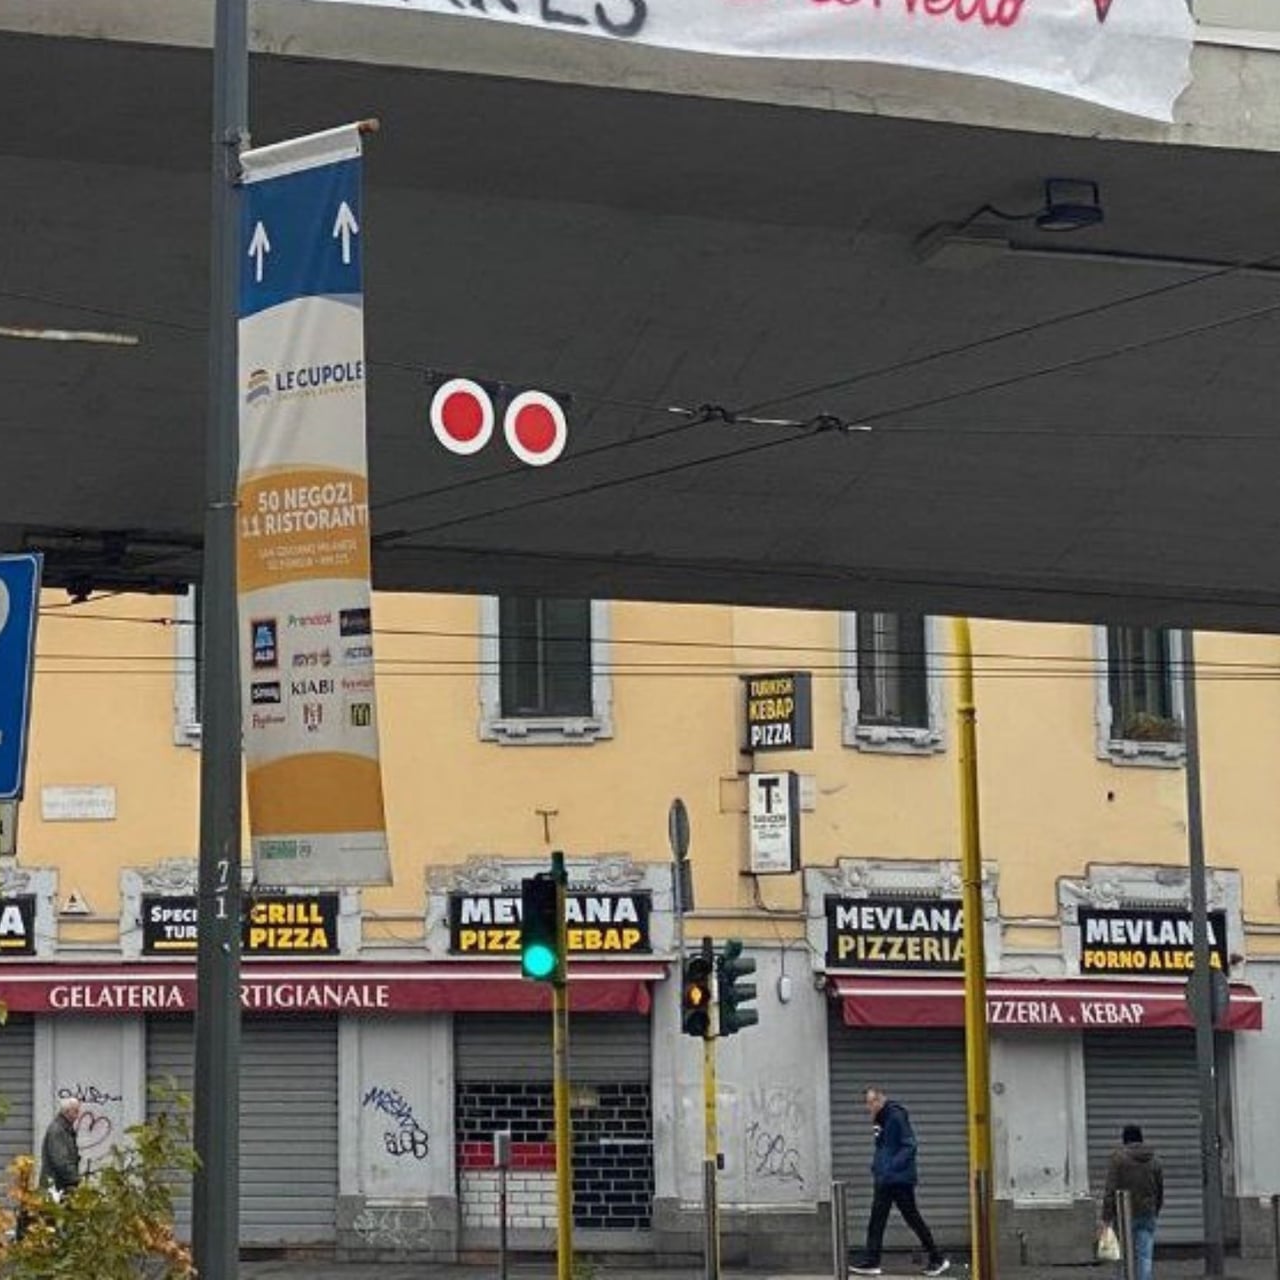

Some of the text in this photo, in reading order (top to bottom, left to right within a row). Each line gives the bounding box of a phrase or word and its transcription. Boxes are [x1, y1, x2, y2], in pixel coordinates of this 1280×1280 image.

[258, 481, 353, 513] 50 NEGOZI
[291, 679, 334, 695] KIABI
[749, 697, 794, 721] KEBAP
[751, 723, 792, 746] PIZZA
[758, 778, 779, 814] T
[250, 903, 324, 924] GRILL
[461, 898, 639, 924] MEANA
[249, 928, 328, 948] PIZZA
[460, 929, 641, 951] PIZZ EBAP
[1084, 949, 1222, 969] FORNO A LEGA
[49, 985, 389, 1008] GELATERIA RTIGIANALE
[985, 1002, 1144, 1024] IZZERIA KEBAP
